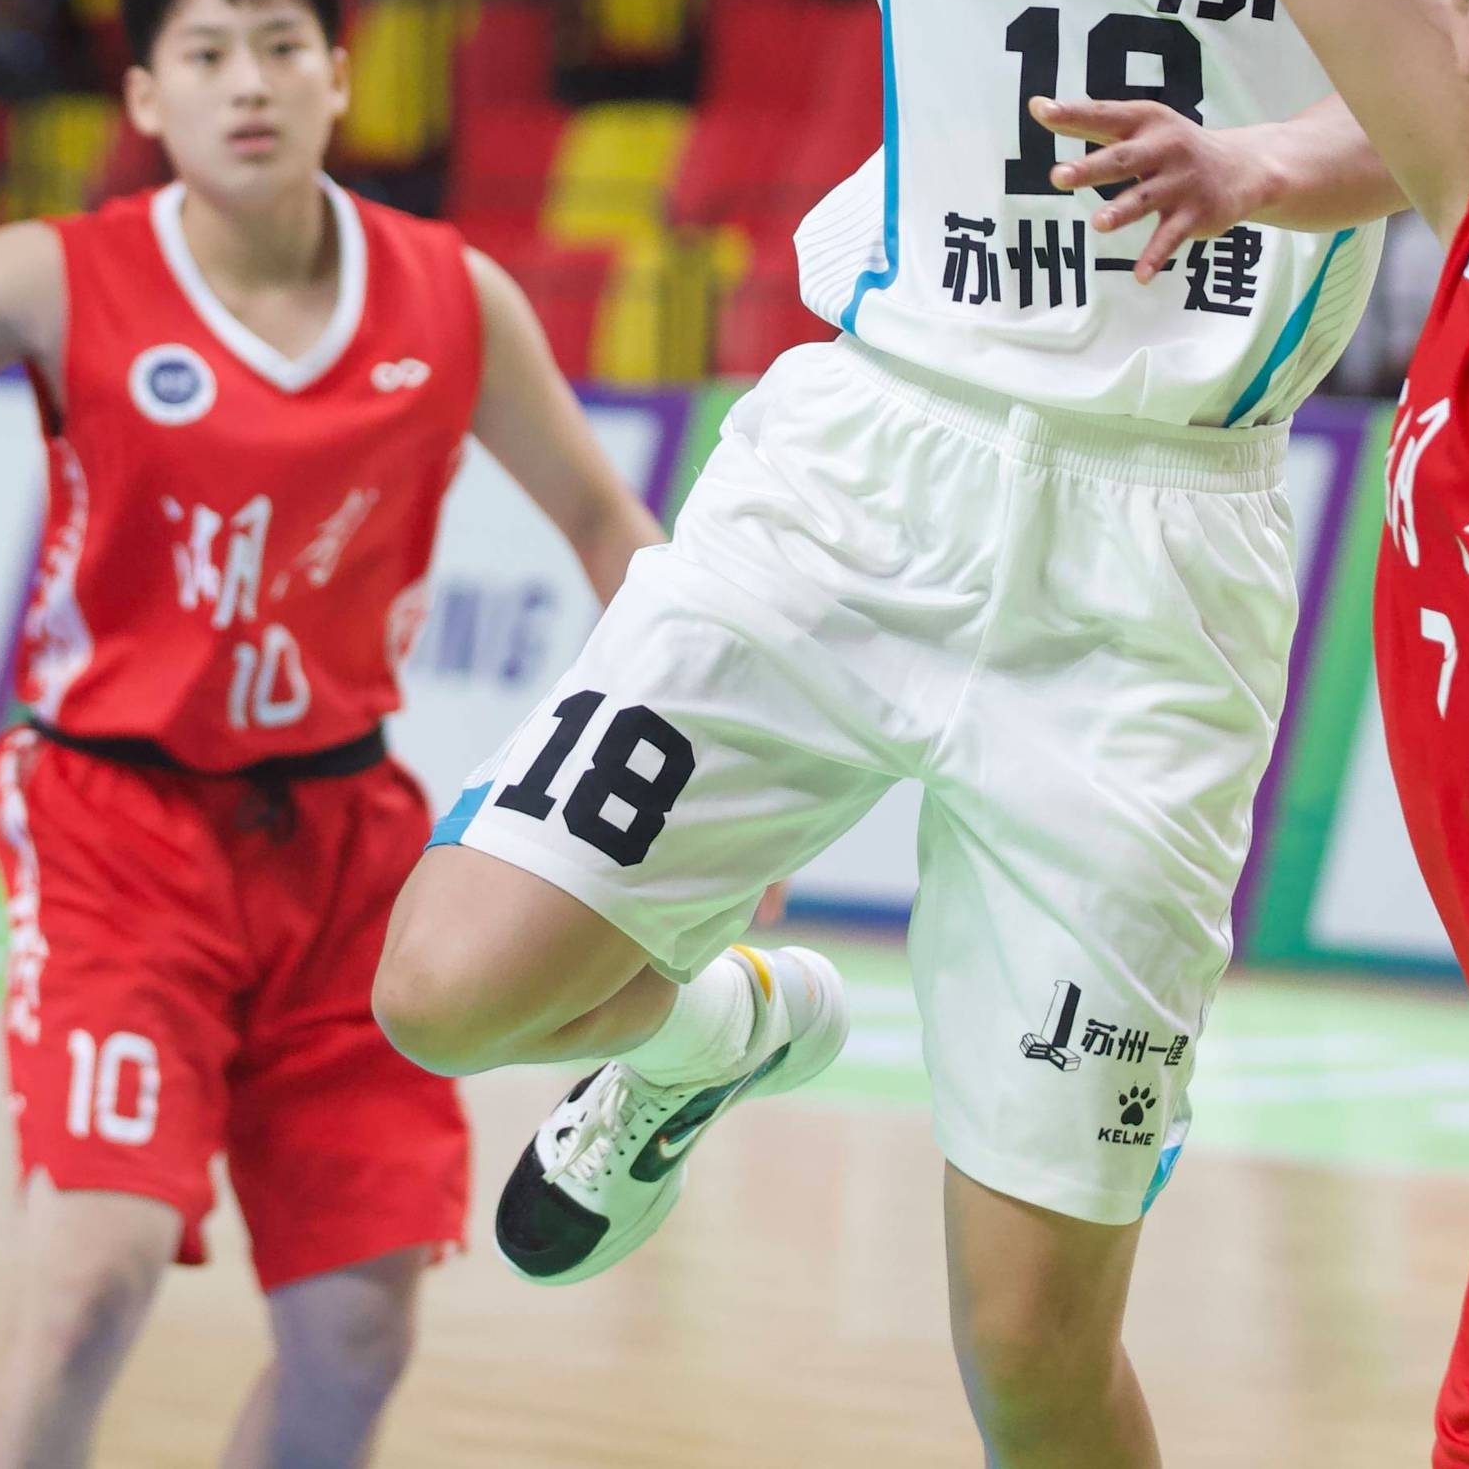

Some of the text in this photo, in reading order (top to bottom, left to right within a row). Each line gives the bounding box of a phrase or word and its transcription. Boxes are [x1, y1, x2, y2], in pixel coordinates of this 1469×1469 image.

[941, 211, 1263, 318] 苏州一建
[226, 621, 312, 732] 10
[1420, 607, 1458, 720] 7
[494, 689, 696, 867] 18
[65, 1027, 162, 1147] 10
[1079, 1017, 1190, 1067] 苏州一建
[1097, 1126, 1156, 1146] KELME
